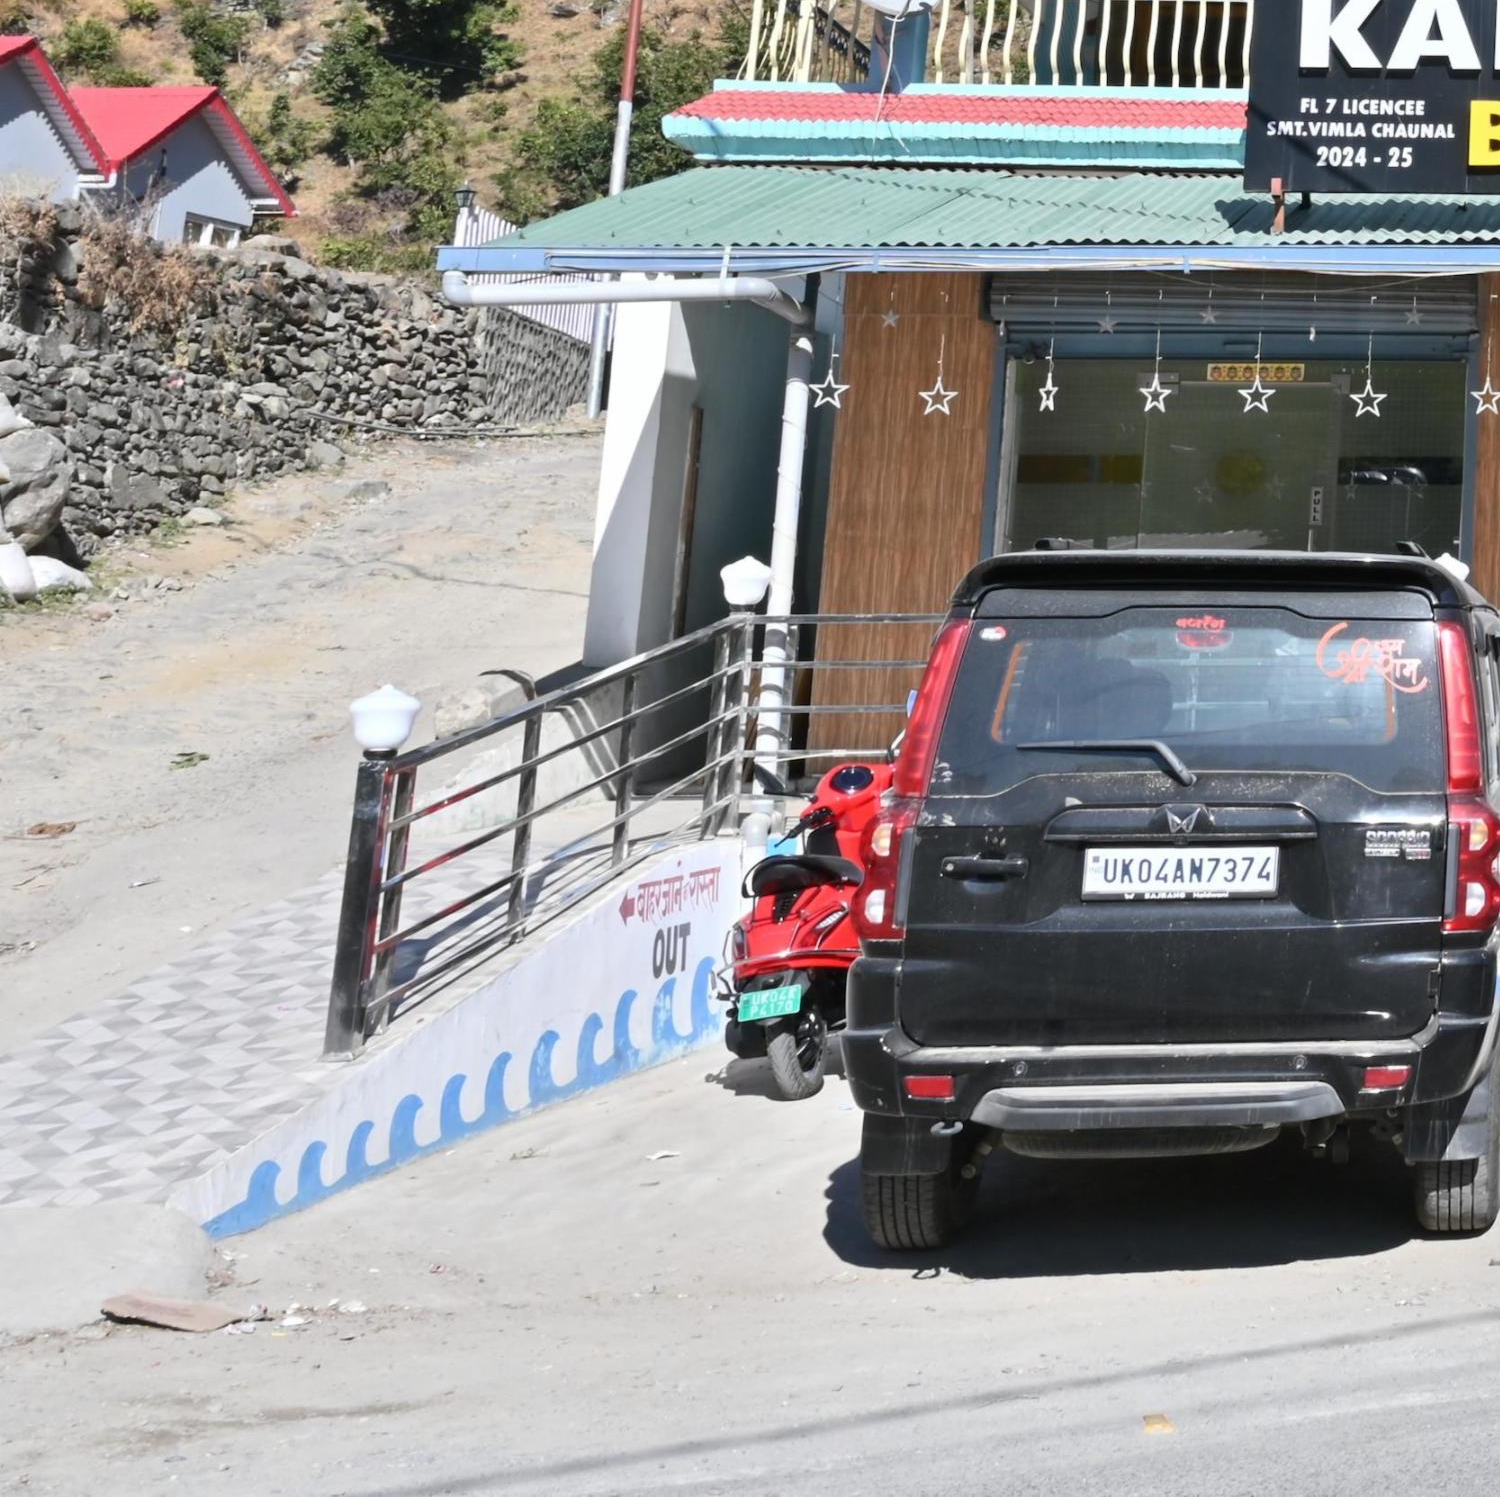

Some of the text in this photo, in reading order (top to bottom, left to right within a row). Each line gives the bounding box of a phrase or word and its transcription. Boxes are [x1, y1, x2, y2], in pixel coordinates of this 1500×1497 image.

[1300, 97, 1425, 116] FL 7 LICENCEE
[1371, 123, 1456, 139] CHAUNAL
[1316, 146, 1367, 167] 2024
[1387, 147, 1413, 168] 25
[1103, 857, 1272, 884] UK04AN7374
[652, 922, 691, 979] OUT
